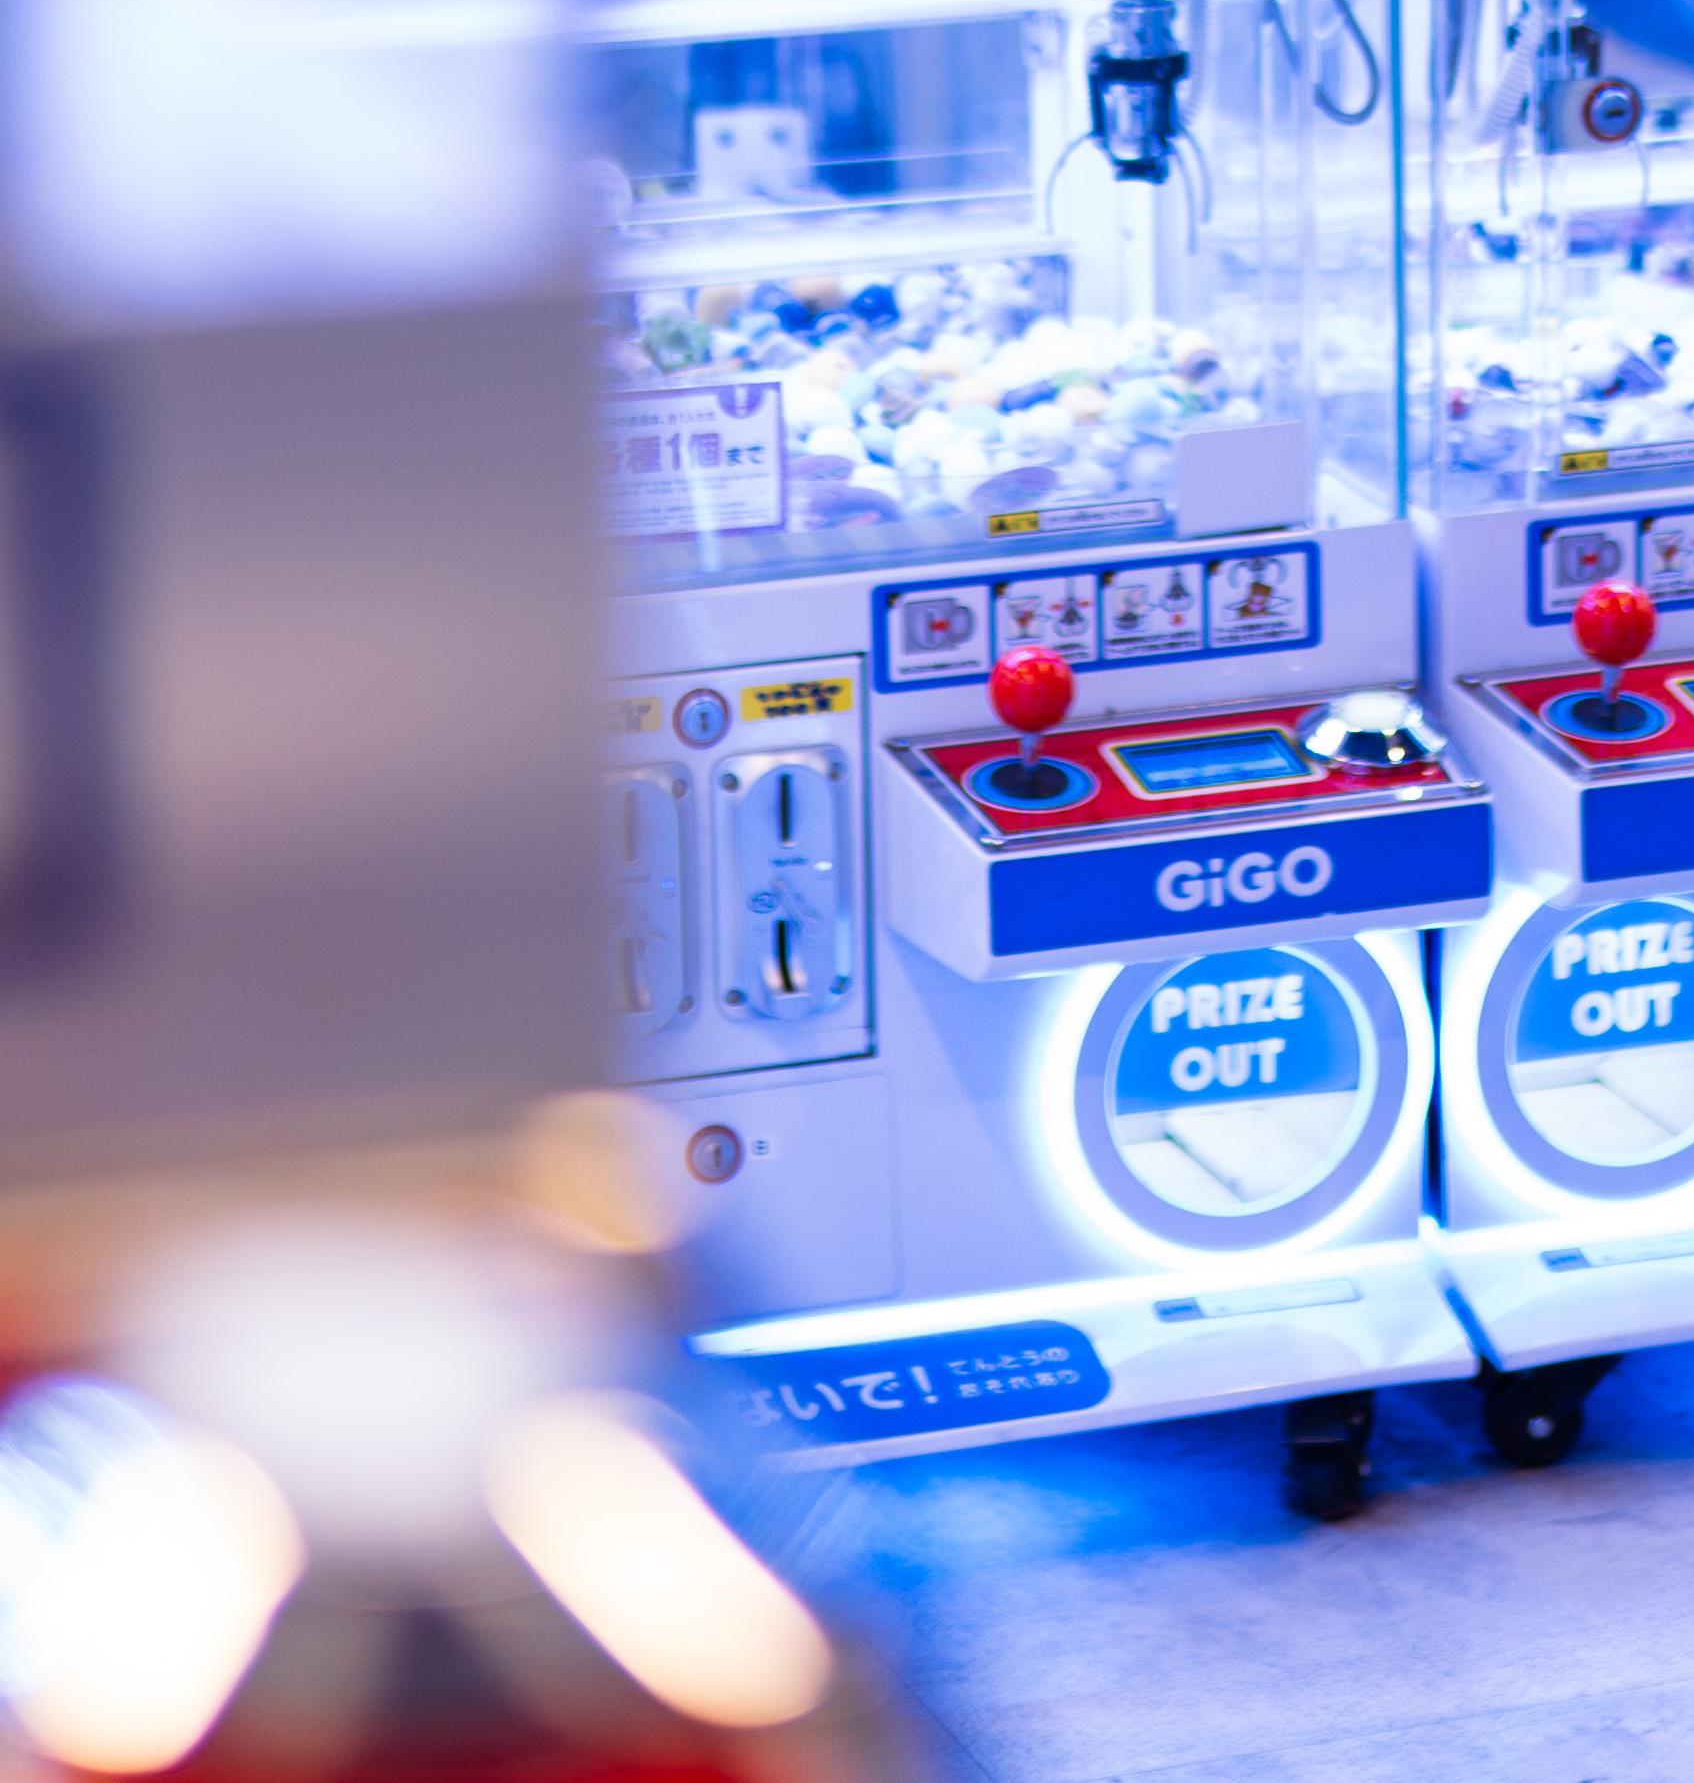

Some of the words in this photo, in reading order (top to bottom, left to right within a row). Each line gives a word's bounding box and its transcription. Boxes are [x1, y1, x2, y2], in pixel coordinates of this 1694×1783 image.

[1156, 845, 1333, 913] GiGO
[1152, 974, 1304, 1034] PRIZE
[1570, 981, 1682, 1037] OUT
[1169, 1038, 1287, 1093] OUT
[945, 1346, 1071, 1377] てんとうの
